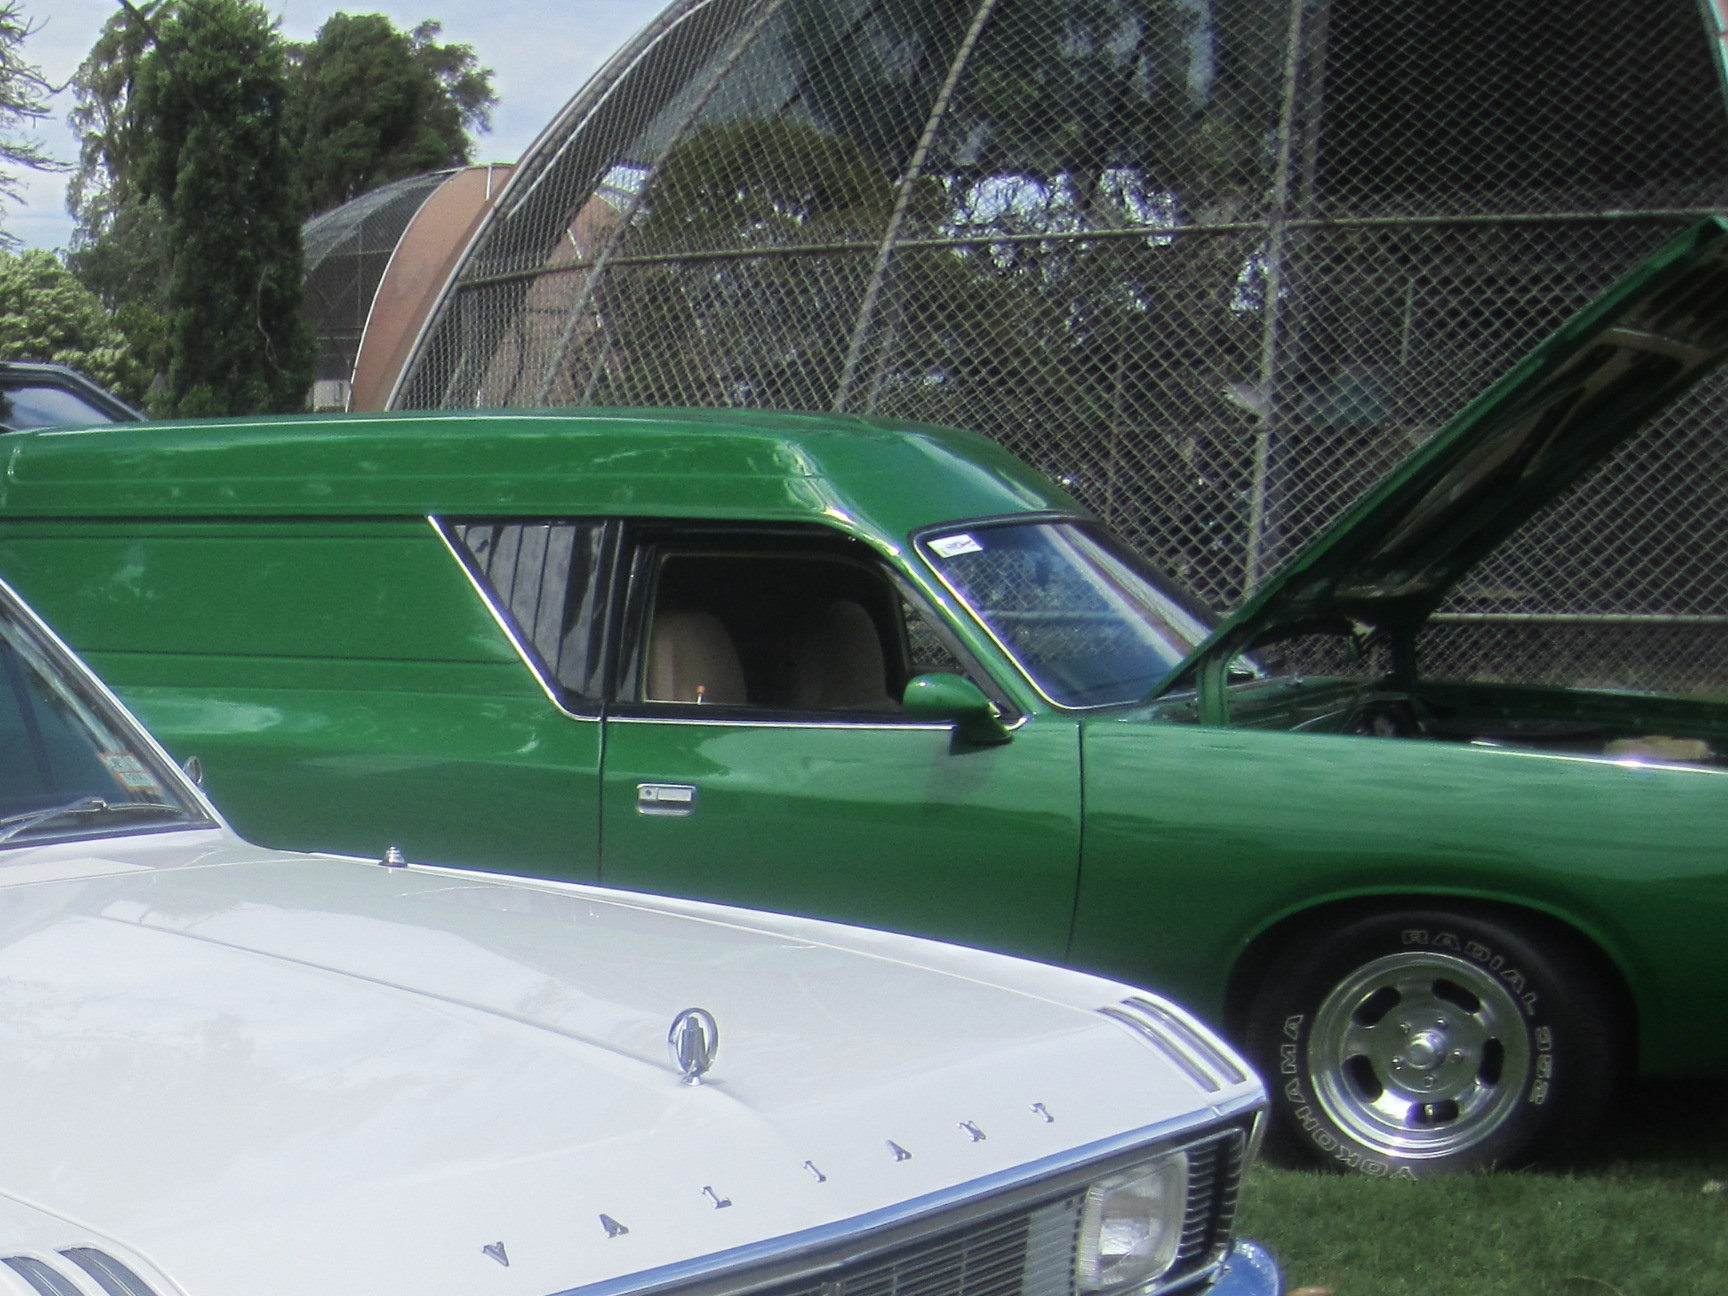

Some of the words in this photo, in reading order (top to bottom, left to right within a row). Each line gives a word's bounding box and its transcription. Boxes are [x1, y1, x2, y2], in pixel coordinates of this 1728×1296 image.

[1402, 929, 1539, 1017] RADIAL
[1280, 1013, 1419, 1183] YOKOHAMA
[480, 1101, 1056, 1268] VALIANT
